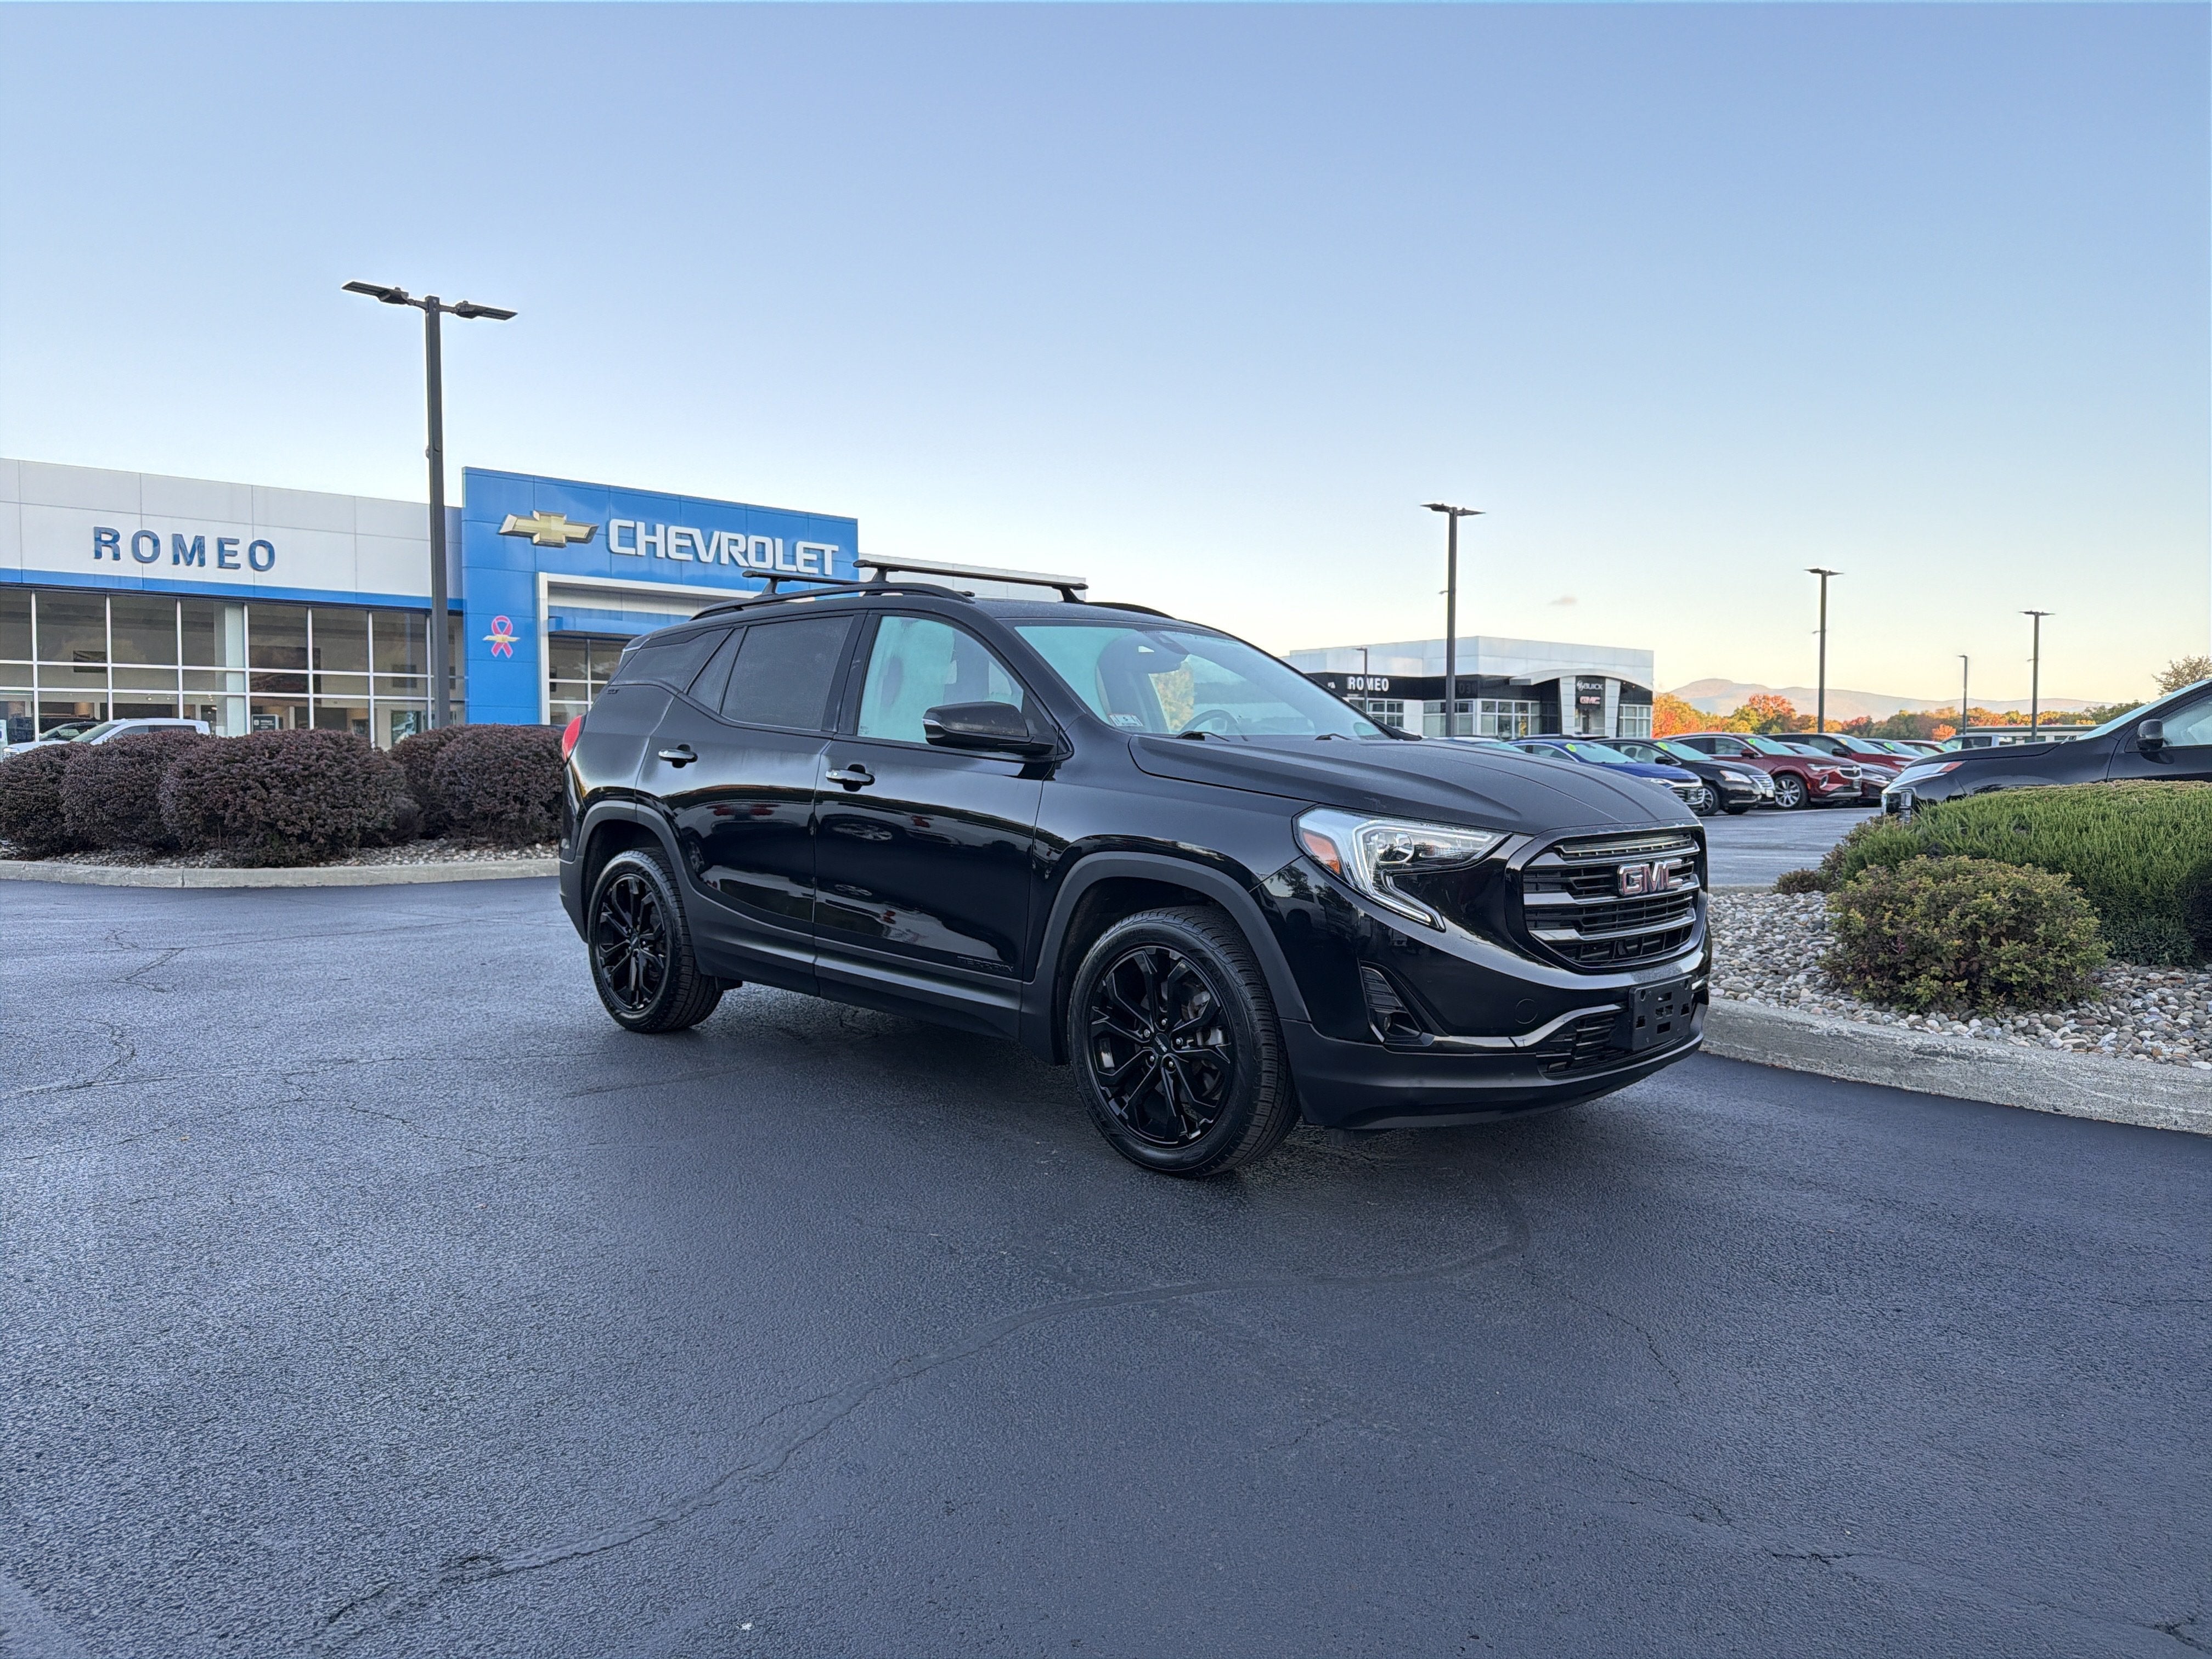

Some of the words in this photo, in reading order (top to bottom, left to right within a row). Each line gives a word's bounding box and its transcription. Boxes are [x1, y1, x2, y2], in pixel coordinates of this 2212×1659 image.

[93, 526, 275, 572] ROMEO
[609, 518, 839, 575] CHEVROLET
[1347, 676, 1389, 692] ROMEO
[1580, 696, 1600, 704] GMC
[1618, 858, 1683, 895] GMC
